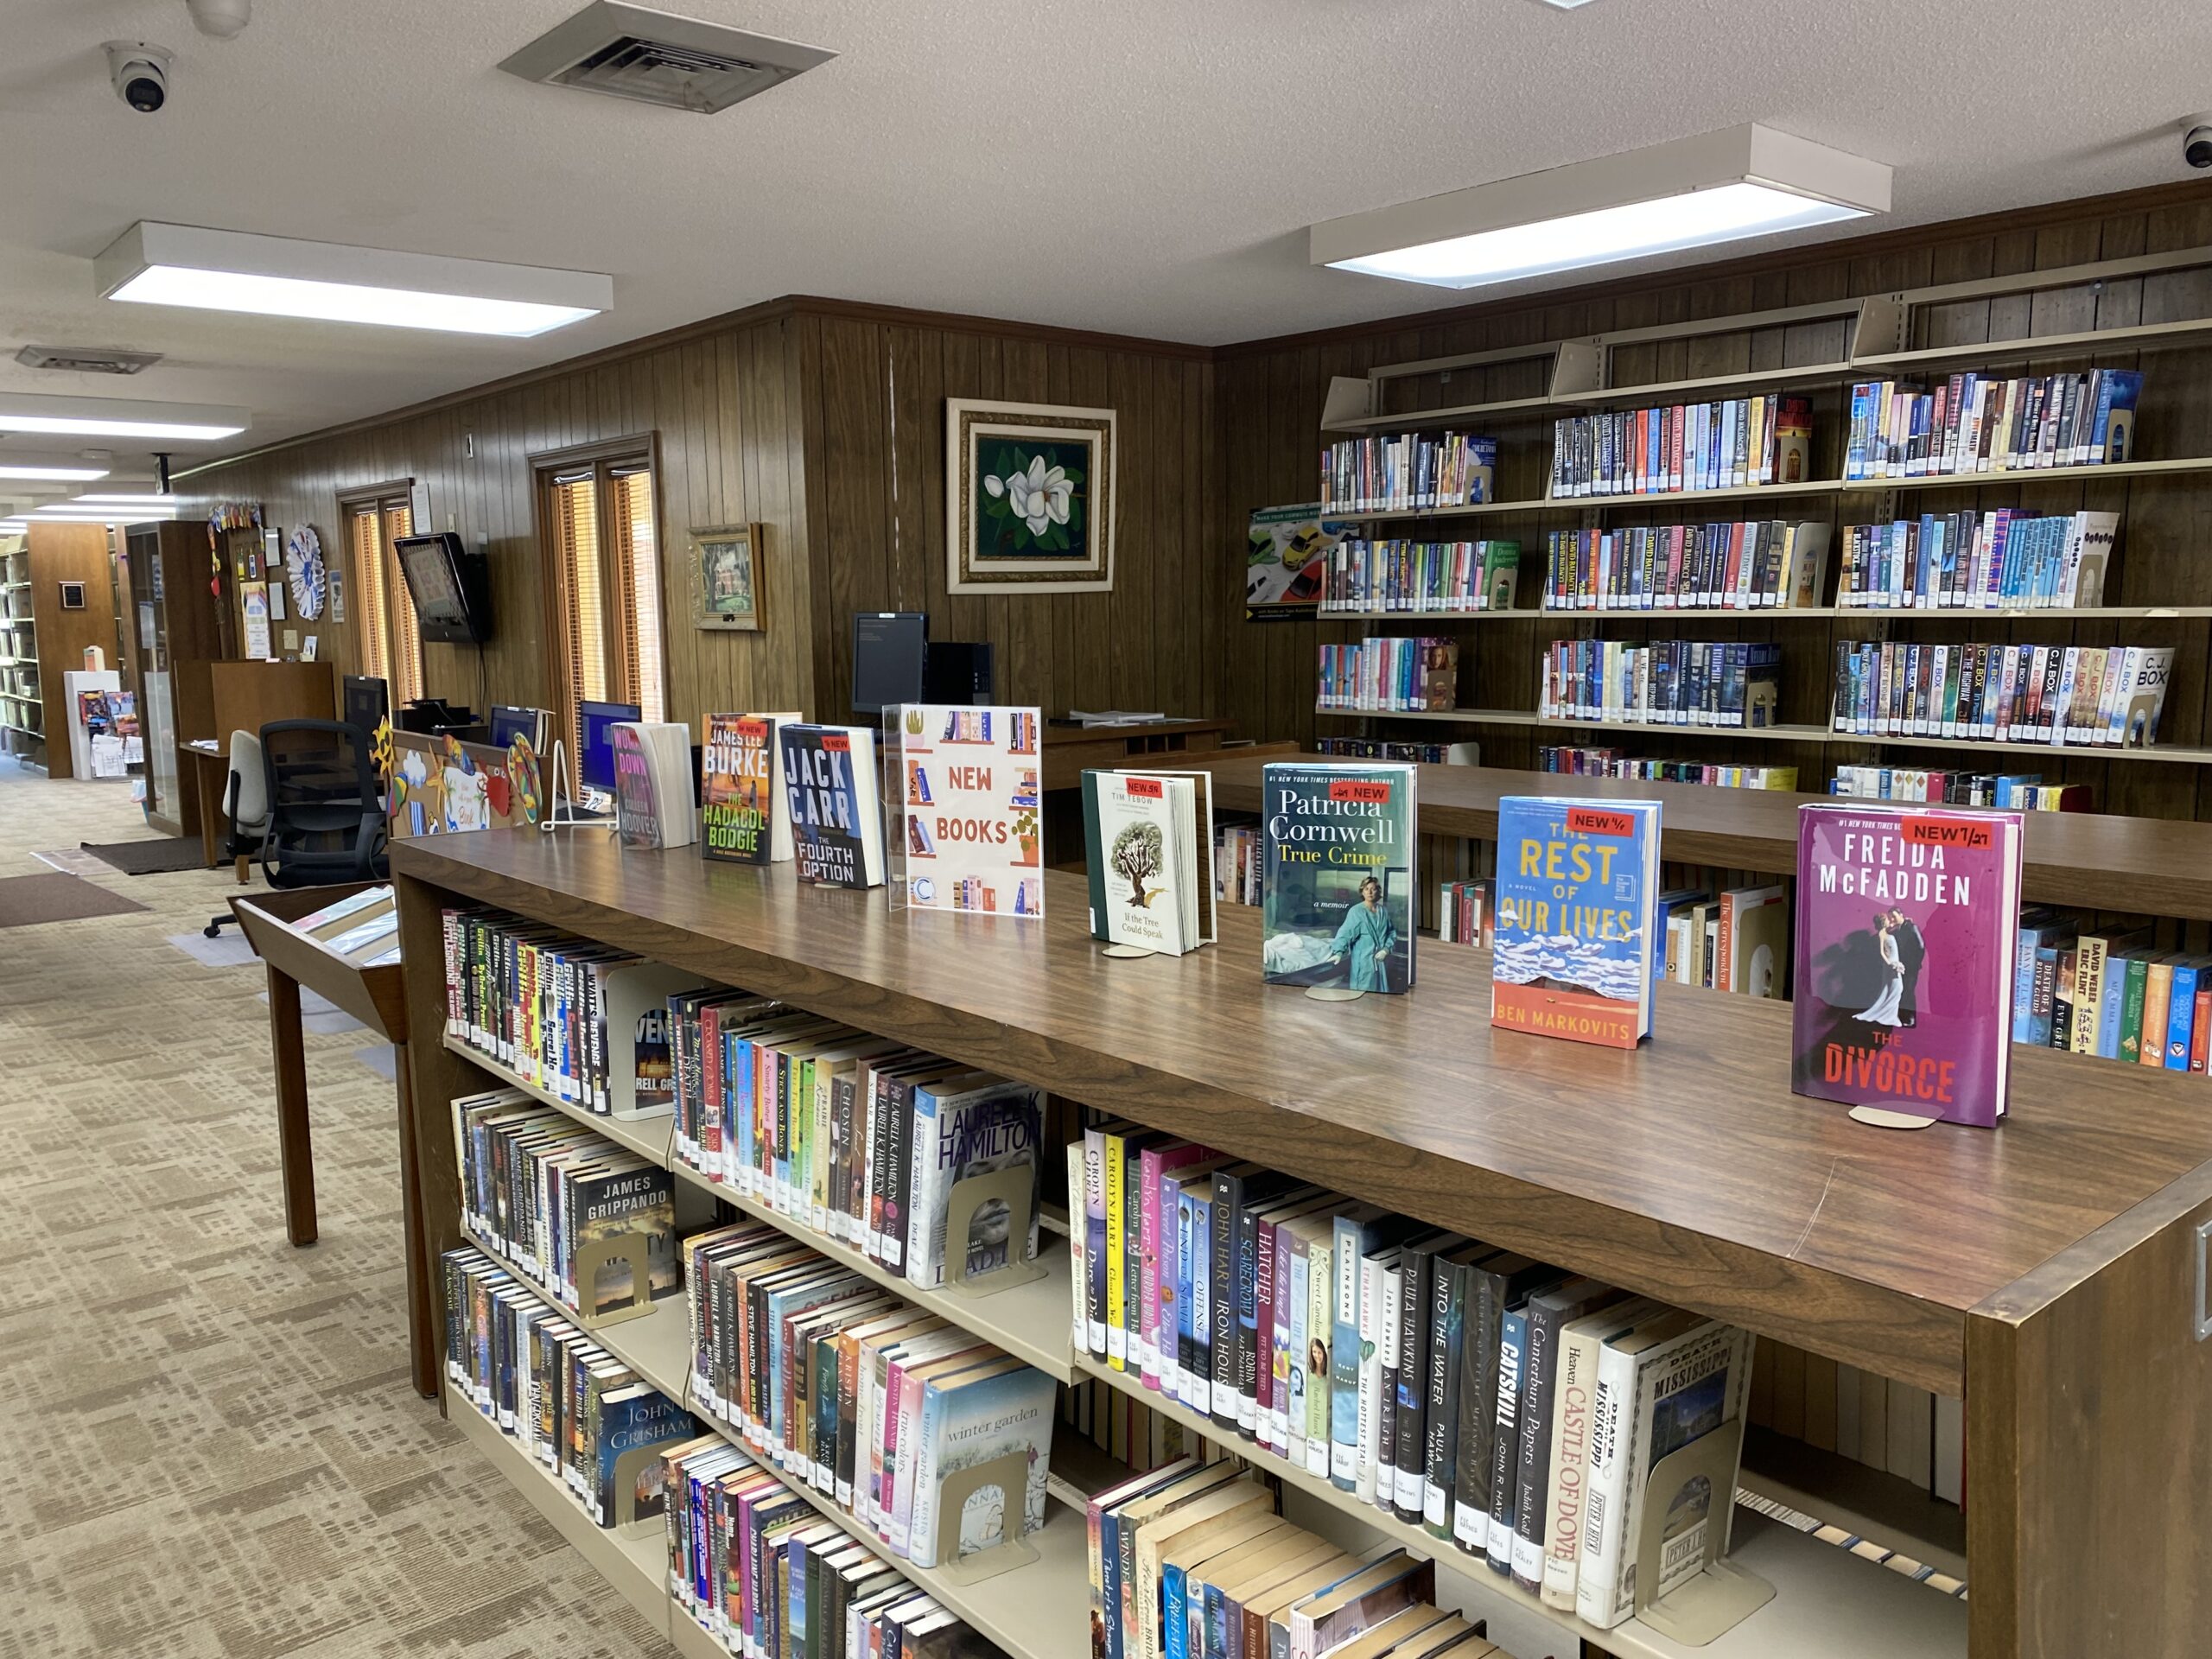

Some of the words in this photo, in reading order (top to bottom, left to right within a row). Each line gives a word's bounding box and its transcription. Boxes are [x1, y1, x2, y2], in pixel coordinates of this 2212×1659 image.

[1643, 561, 1652, 591] BALDACCI
[1964, 658, 1974, 671] THE
[1975, 668, 1984, 687] BOX
[2137, 671, 2168, 686] BOX
[2145, 657, 2165, 669] C.J.
[1960, 672, 1971, 702] HIGHWAY
[2046, 670, 2057, 692] BOX
[2063, 671, 2071, 693] BOX
[619, 753, 646, 775] DOWN
[705, 747, 768, 778] BURKE
[786, 747, 846, 789] JACK
[949, 766, 991, 791] NEW
[1128, 782, 1146, 791] NEW
[1354, 788, 1385, 798] NEW
[728, 793, 742, 805] THE
[788, 787, 851, 830] CARR
[1128, 795, 1153, 804] TEBOW
[1279, 790, 1382, 817] Patricia
[620, 812, 658, 835] HOOVER
[704, 805, 765, 830] HADACOL
[937, 817, 1007, 844] BOOKS
[1269, 816, 1395, 843] Cornwell
[1914, 825, 1958, 841] NEW
[709, 827, 758, 851] BOOGIE
[798, 842, 854, 864] FOURTH
[1278, 844, 1321, 862] True
[1328, 847, 1387, 865] Crime
[1844, 834, 1945, 870] FREIDA
[803, 861, 854, 882] OPTION
[1521, 838, 1618, 885] REST
[1553, 885, 1579, 900] OF
[1820, 865, 1970, 906] McFADDEN
[1122, 923, 1141, 934] Could
[1143, 927, 1163, 939] Speak
[1133, 913, 1142, 923] the
[1143, 916, 1159, 927] Tree
[1502, 897, 1549, 932] OUR
[1560, 905, 1632, 943] LIVES
[1719, 922, 1729, 983] Correspondent
[2092, 943, 2101, 971] DAVID
[588, 974, 597, 1016] WYATT'S
[2043, 988, 2050, 999] OF
[2078, 969, 2088, 996] FLINT
[2088, 972, 2099, 1003] WEBER
[2032, 988, 2041, 1013] GUIDE
[1497, 1004, 1525, 1023] BEN
[1532, 1011, 1629, 1039] MARKOVITS
[590, 1020, 601, 1067] REVENGE
[1872, 1031, 1904, 1047] THE
[842, 1084, 850, 1146] CHOSEN
[938, 1116, 1042, 1170] HAMILTON
[603, 1176, 651, 1199] JAMES
[1089, 1149, 1099, 1207] CAROLYN
[588, 1191, 667, 1220] GRIPPANDO
[1108, 1212, 1116, 1250] HART
[1216, 1200, 1230, 1248] JOHN
[1130, 1263, 1140, 1293] Letter
[1216, 1251, 1230, 1292] HART
[1239, 1237, 1252, 1316] SCARECROW
[1258, 1232, 1272, 1306] HATCHER
[1343, 1239, 1351, 1319] PLAINSONG
[1363, 1266, 1371, 1299] ETHAN
[1131, 1293, 1140, 1315] from
[1385, 1287, 1394, 1315] John
[1404, 1268, 1417, 1313] PAULA
[1436, 1274, 1449, 1313] INTO
[1434, 1317, 1447, 1349] THE
[1532, 1312, 1547, 1326] The
[1402, 1314, 1416, 1381] HAWKINS
[1669, 1338, 1721, 1367] DEATH
[845, 1355, 854, 1406] KRISTIN
[1245, 1351, 1255, 1384] ROBIN
[1338, 1363, 1354, 1372] KENT
[1431, 1353, 1446, 1405] WATER
[1524, 1328, 1546, 1411] Canterbury
[1568, 1347, 1580, 1385] Heaven
[1654, 1346, 1732, 1400] MISSISSIPPI
[859, 1364, 868, 1402] home
[1497, 1340, 1519, 1428] CATSKILL
[628, 1402, 675, 1425] JOHN
[900, 1410, 910, 1438] true
[948, 1422, 992, 1444] winter
[995, 1407, 1039, 1433] garden
[1591, 1379, 1609, 1469] MISSISSIPPI
[610, 1418, 691, 1450] GRISHAM
[923, 1413, 931, 1449] winter
[1434, 1422, 1445, 1463] PAULA
[1523, 1416, 1541, 1466] Papers
[1605, 1402, 1619, 1460] DEATH
[898, 1439, 909, 1473] colors
[918, 1450, 929, 1490] garden
